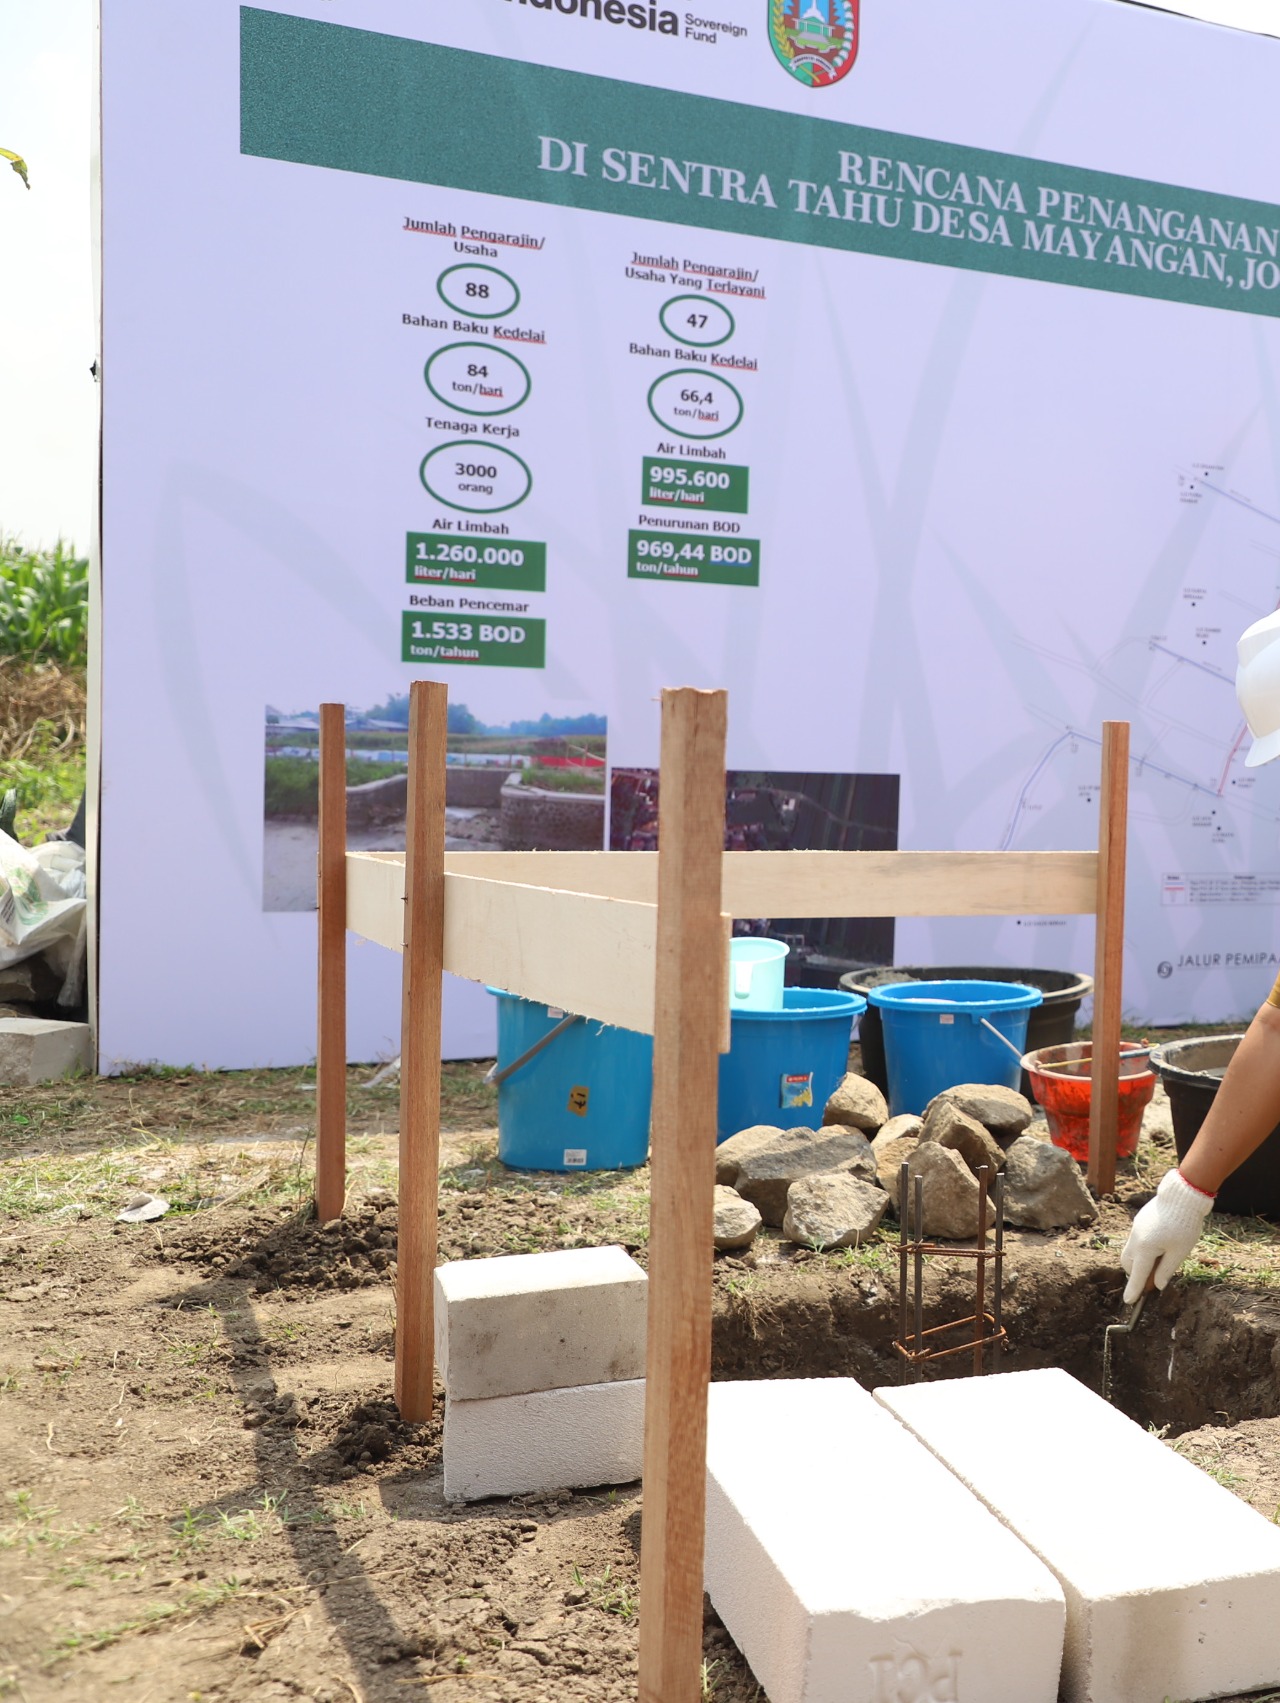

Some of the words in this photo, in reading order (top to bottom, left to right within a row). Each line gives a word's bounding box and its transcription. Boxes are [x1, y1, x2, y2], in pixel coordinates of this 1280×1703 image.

[504, 0, 679, 36] onesia
[684, 13, 748, 37] Sovereign
[684, 27, 717, 44] Fund
[537, 135, 588, 176] DI
[601, 147, 778, 208] SENTRA
[788, 179, 903, 228] TAHU
[911, 201, 1013, 247] DESA
[1022, 219, 1233, 288] MAYANGAN,
[838, 150, 1026, 214] RENCANA
[1036, 186, 1279, 257] PENANGANAN
[403, 216, 457, 235] Jumlah
[461, 225, 546, 249] Pengarajin/
[454, 241, 498, 258] Usaha
[631, 252, 679, 271] Jumlah
[683, 259, 759, 283] Pengarajin/
[465, 282, 489, 298] 88
[625, 267, 666, 283] Usaha
[670, 273, 703, 290] Yang
[706, 278, 766, 298] Terlayani
[402, 313, 448, 329] Bahan
[453, 320, 489, 335] Baku
[493, 325, 546, 342] Kedelai
[686, 313, 708, 329] 47
[629, 342, 670, 359] Bahan
[675, 349, 707, 363] Baku
[711, 353, 758, 370] Kedelai
[467, 364, 488, 378] 84
[452, 381, 503, 396] ton/hari
[680, 389, 713, 405] 66,4
[674, 406, 719, 421] ton/hari
[425, 417, 478, 434] Tenaga
[482, 423, 520, 439] Kerja
[657, 442, 676, 454] Air
[679, 445, 726, 460] Limbah
[455, 463, 497, 478] 3000
[650, 466, 730, 489] 995.600
[458, 482, 493, 496] orang
[649, 486, 704, 503] liter/hari
[432, 518, 453, 530] Air
[457, 520, 509, 535] Limbah
[638, 514, 709, 531] Penurunan
[713, 521, 741, 533] BOD
[416, 542, 525, 567] 1.260.000
[636, 540, 705, 562] 969,44
[710, 545, 752, 564] BOD
[414, 565, 476, 580] liter/hari
[636, 561, 699, 576] ton/tahun
[409, 595, 454, 608] Beban
[459, 597, 530, 612] Pencemar
[411, 621, 473, 641] 1.533
[479, 624, 526, 643] BOD
[410, 644, 479, 658] ton/tahun
[1177, 953, 1221, 967] JALUR
